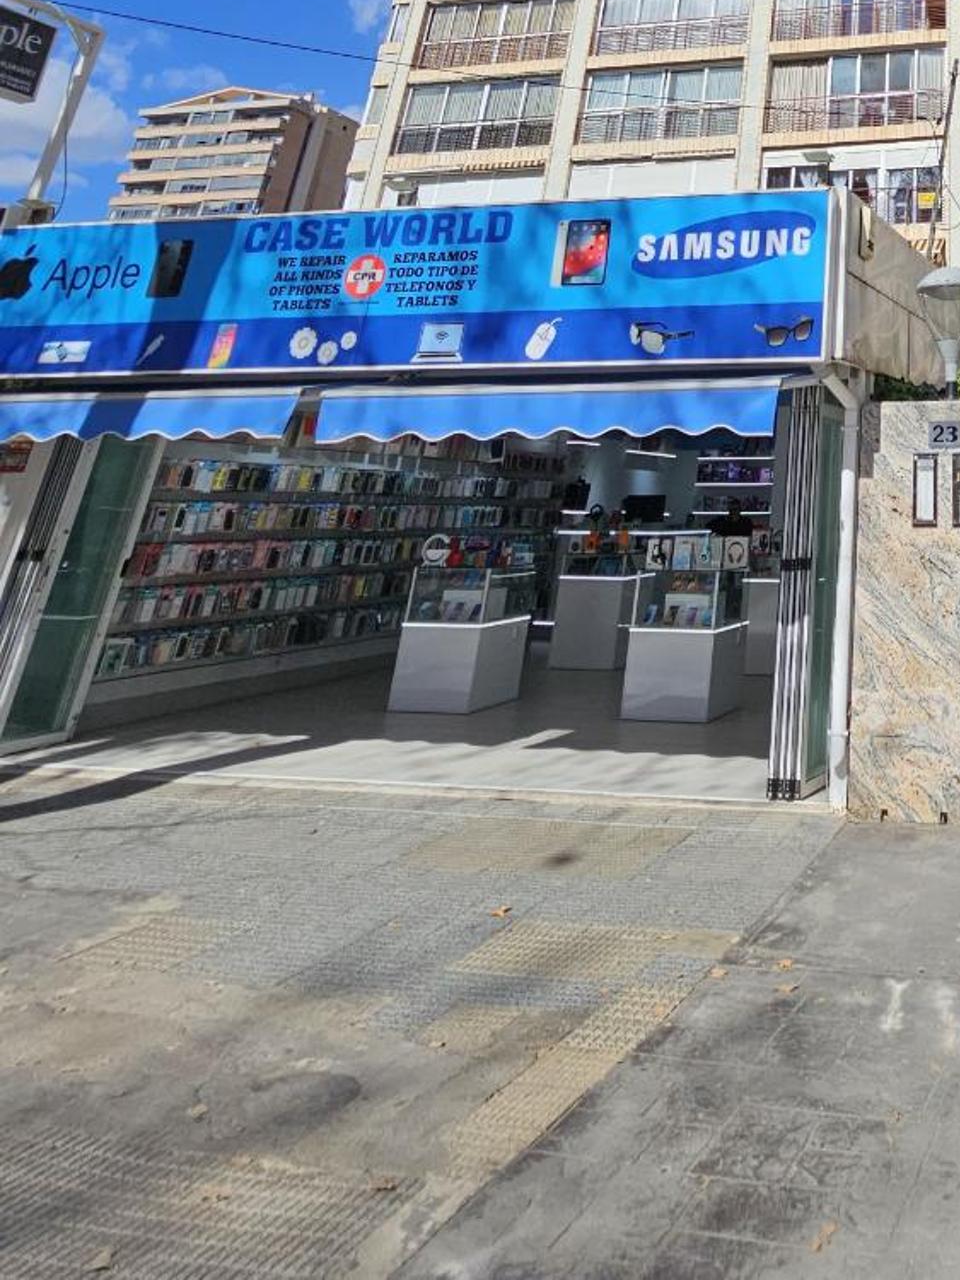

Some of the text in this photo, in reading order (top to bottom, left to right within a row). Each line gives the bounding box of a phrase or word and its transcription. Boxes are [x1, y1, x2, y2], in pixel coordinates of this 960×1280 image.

[244, 210, 513, 253] CASE WORLD
[636, 226, 812, 263] SAMSUNG
[278, 255, 346, 267] WE REPAIR
[394, 250, 478, 263] REPARAMOS
[41, 256, 140, 299] Apple
[274, 269, 343, 282] ALL KINDS
[389, 264, 479, 278] TODO TIPO DE
[269, 284, 341, 296] OF PHONES
[385, 279, 477, 293] TELEFONOS Y
[272, 299, 332, 311] TABLETS
[397, 294, 459, 308] TABLETS
[933, 424, 959, 443] 23
